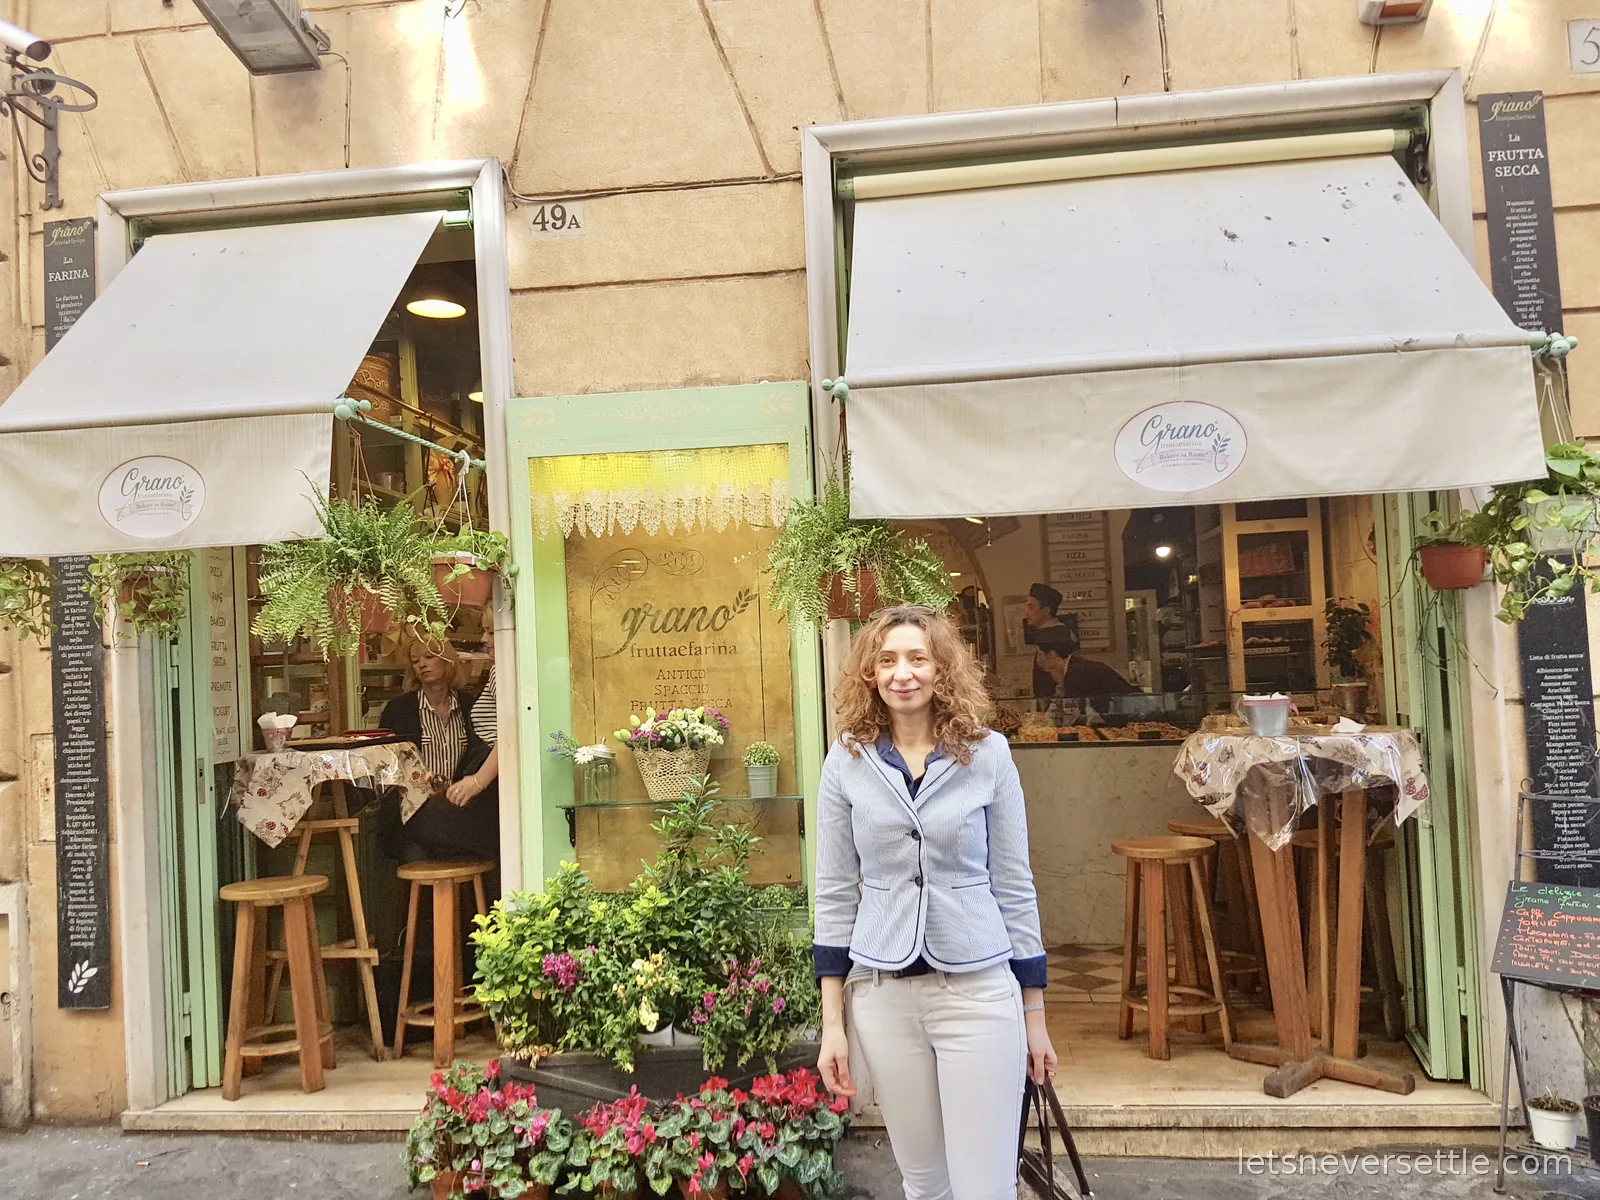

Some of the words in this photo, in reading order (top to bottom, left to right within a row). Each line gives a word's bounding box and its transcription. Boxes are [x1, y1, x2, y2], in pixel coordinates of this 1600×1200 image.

[1484, 100, 1532, 122] grano
[1509, 134, 1520, 142] La
[1488, 148, 1544, 161] FRUTTA
[1495, 164, 1540, 177] SECCA
[532, 204, 581, 231] 49A
[45, 227, 84, 247] grano
[48, 269, 89, 282] FARINA
[1138, 414, 1218, 462] Grano
[118, 468, 184, 508] Grano
[210, 566, 223, 578] PIZZA
[1066, 590, 1092, 598] ZUPPE
[600, 603, 735, 657] grano
[631, 642, 738, 658] fruttaefarina
[656, 669, 706, 680] ANTICO
[654, 684, 710, 696] SPACCIO
[630, 700, 685, 712] FRUTTA
[691, 698, 734, 708] SECCA
